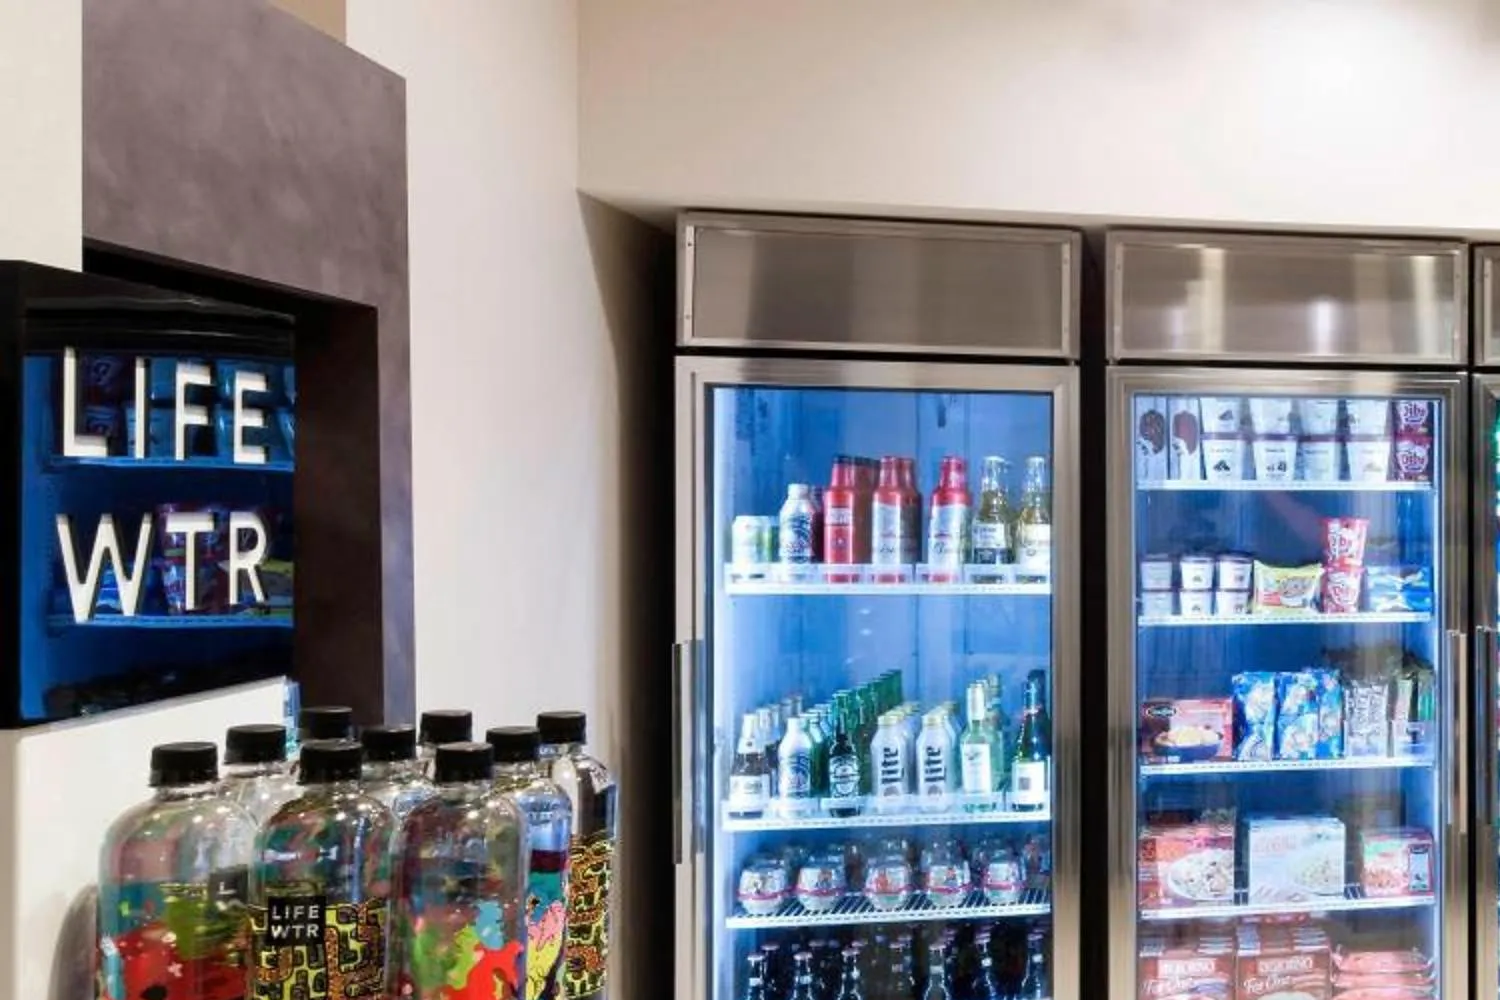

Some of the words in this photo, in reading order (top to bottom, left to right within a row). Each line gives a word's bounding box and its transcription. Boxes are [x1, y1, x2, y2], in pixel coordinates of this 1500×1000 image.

[62, 345, 268, 464] LIFE
[55, 511, 271, 624] WTR
[270, 922, 320, 939] WTR
[271, 904, 320, 921] LIFE
